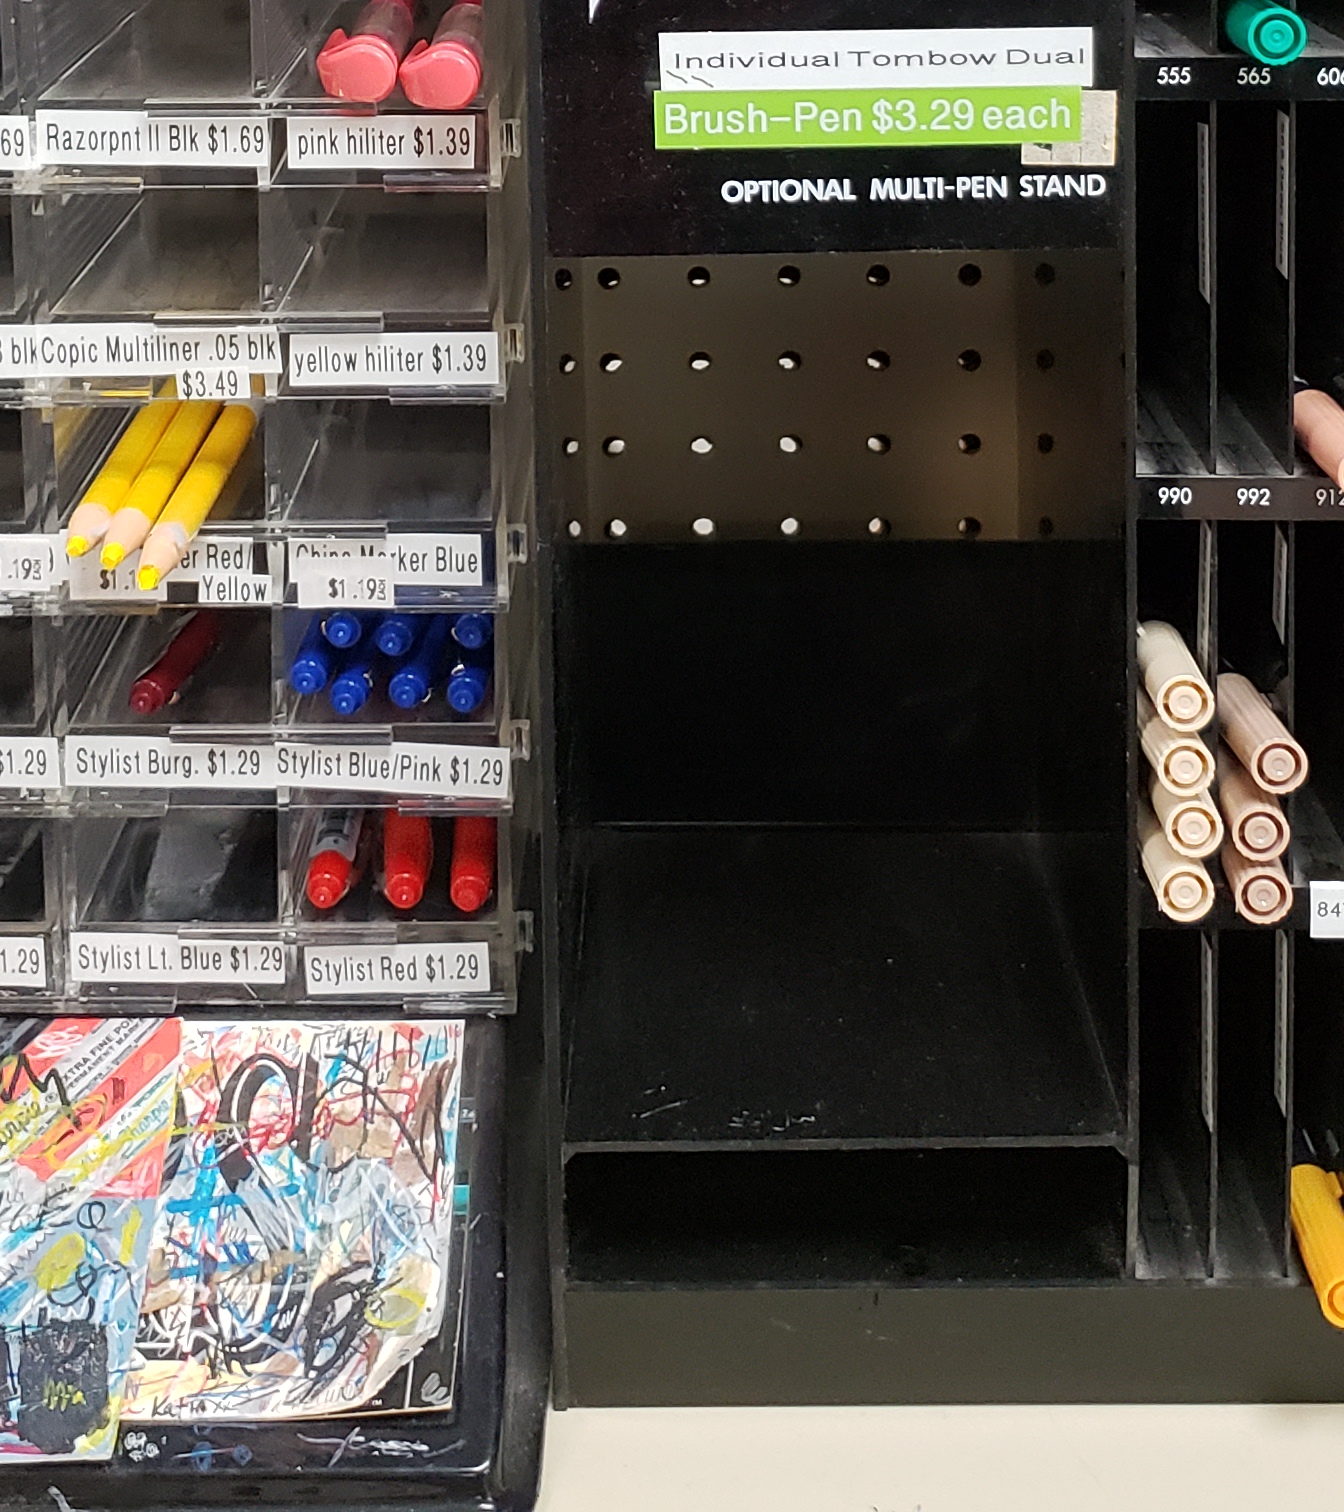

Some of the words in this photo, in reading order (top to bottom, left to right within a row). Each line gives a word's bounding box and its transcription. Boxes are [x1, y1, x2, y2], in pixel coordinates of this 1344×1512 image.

[674, 50, 839, 70] Individual
[848, 50, 997, 68] Tombow
[1006, 47, 1085, 66] Dual
[1156, 67, 1191, 85] 555
[665, 101, 862, 135] Brush-Pen
[872, 99, 974, 134] $3.29
[982, 98, 1071, 130] each
[47, 125, 140, 156] Razorpnt
[168, 124, 200, 153] Blk
[207, 124, 265, 154] $1.69
[297, 126, 340, 158] pink
[347, 127, 405, 157] hiliter
[413, 126, 470, 156] $1.39
[721, 178, 856, 203] OPTIONAL
[870, 177, 1008, 201] MULTI-PEN
[1019, 175, 1106, 199] STAND
[12, 337, 38, 366] blk
[295, 346, 356, 376] yellow
[364, 344, 424, 373] hiliter
[432, 343, 487, 372] $1.39
[1158, 487, 1192, 505] 990
[200, 577, 266, 603] Yellow
[277, 749, 342, 779] Stylist
[349, 752, 442, 783] Blue/Pink
[450, 757, 504, 786] $1.29
[311, 957, 376, 986] Stylist
[382, 957, 417, 984] Red
[425, 956, 478, 982] $1.29
